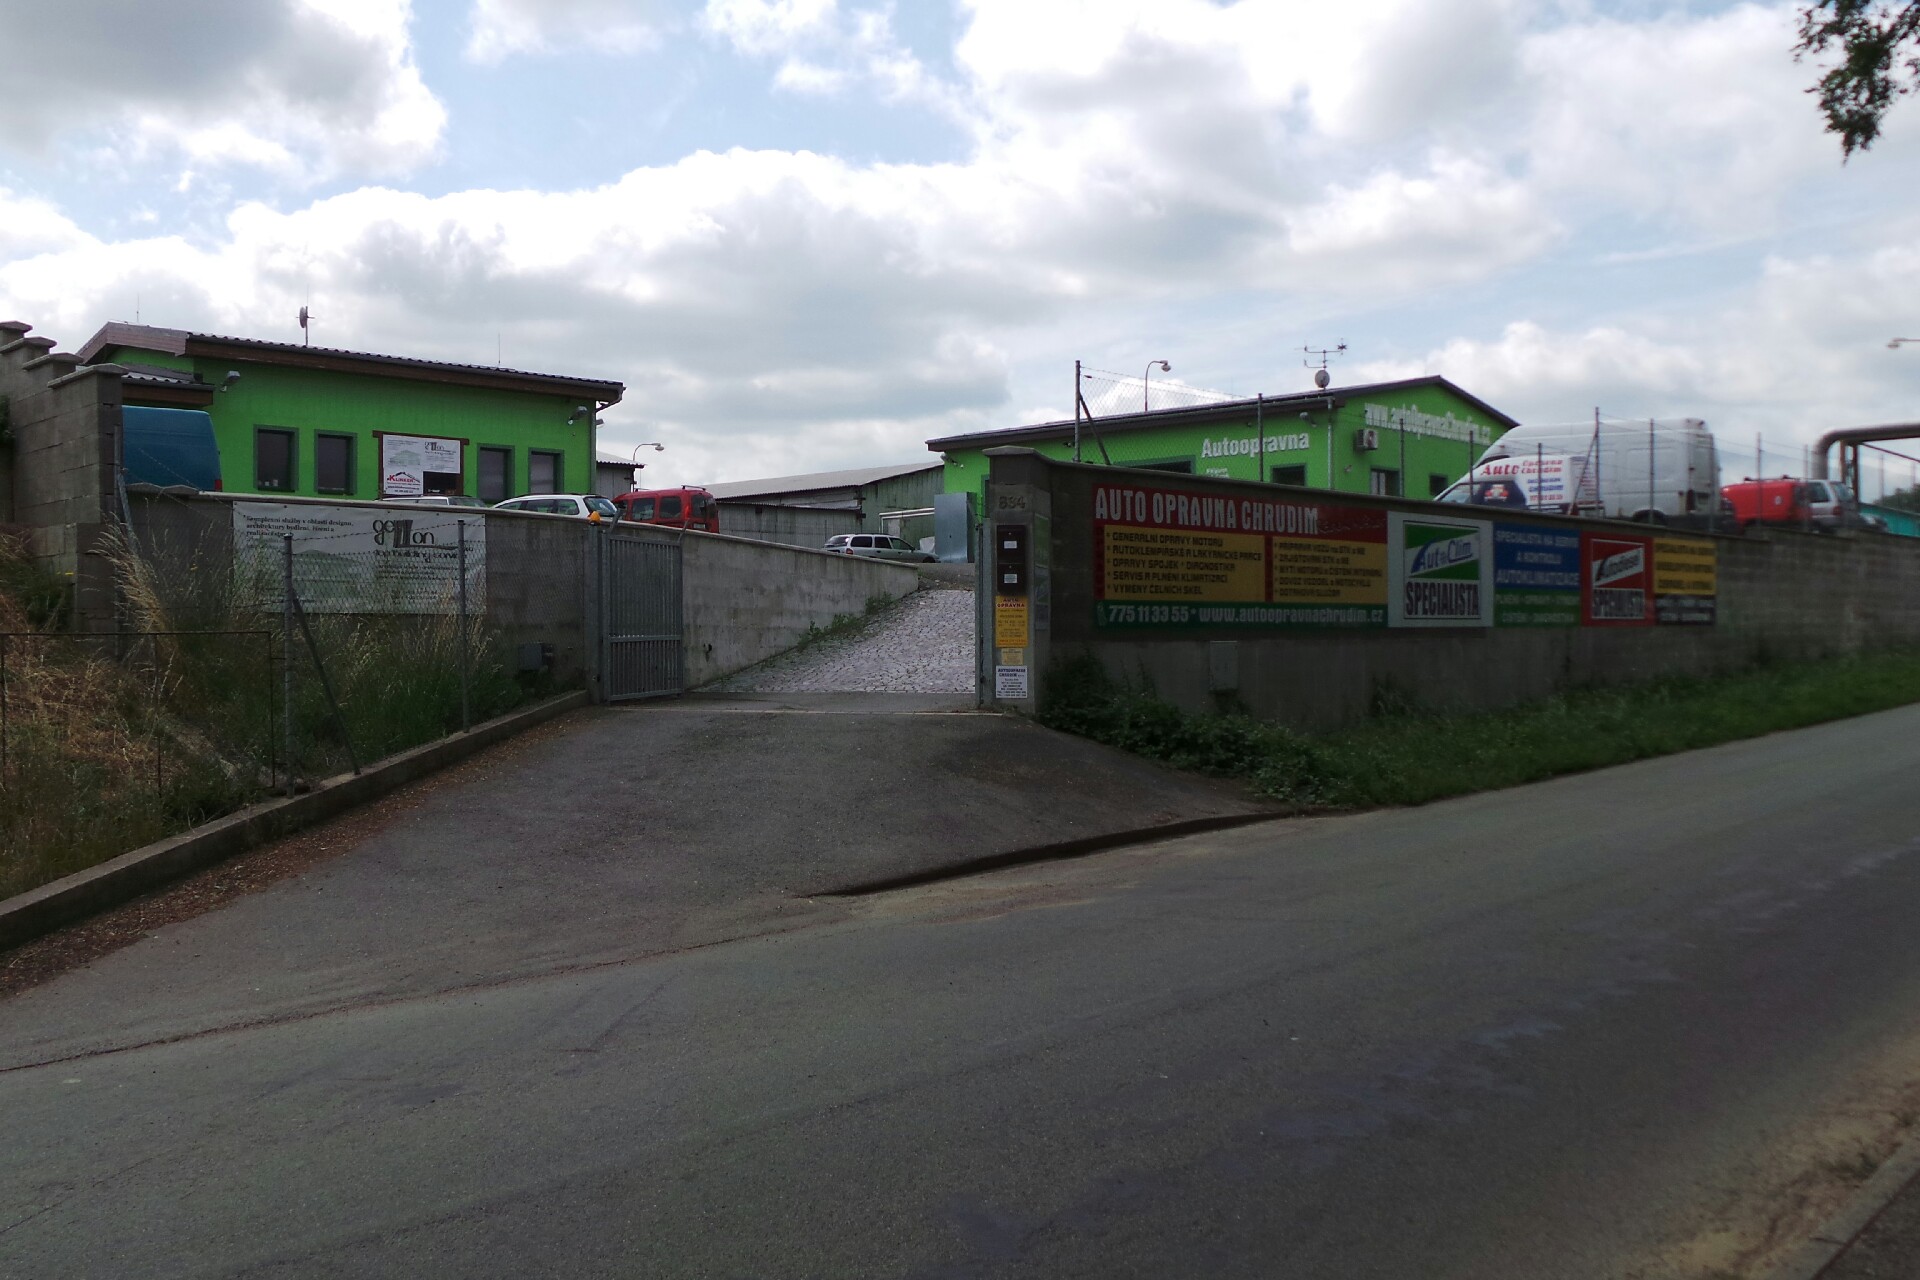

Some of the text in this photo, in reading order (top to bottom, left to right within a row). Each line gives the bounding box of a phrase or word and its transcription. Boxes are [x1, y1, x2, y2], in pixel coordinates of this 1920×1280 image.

[1201, 432, 1310, 459] Autoopravna
[1480, 464, 1520, 477] Auto
[1095, 487, 1147, 523] AUTO
[1152, 492, 1238, 529] OPRAVNA
[1240, 500, 1319, 535] CHRUDIM
[1112, 570, 1144, 581] SERVIS
[1405, 581, 1480, 616] SPECIALISTA
[1108, 604, 1136, 623] 775
[1137, 605, 1151, 623] 11
[1151, 605, 1170, 623] 33
[1170, 605, 1190, 624] 55
